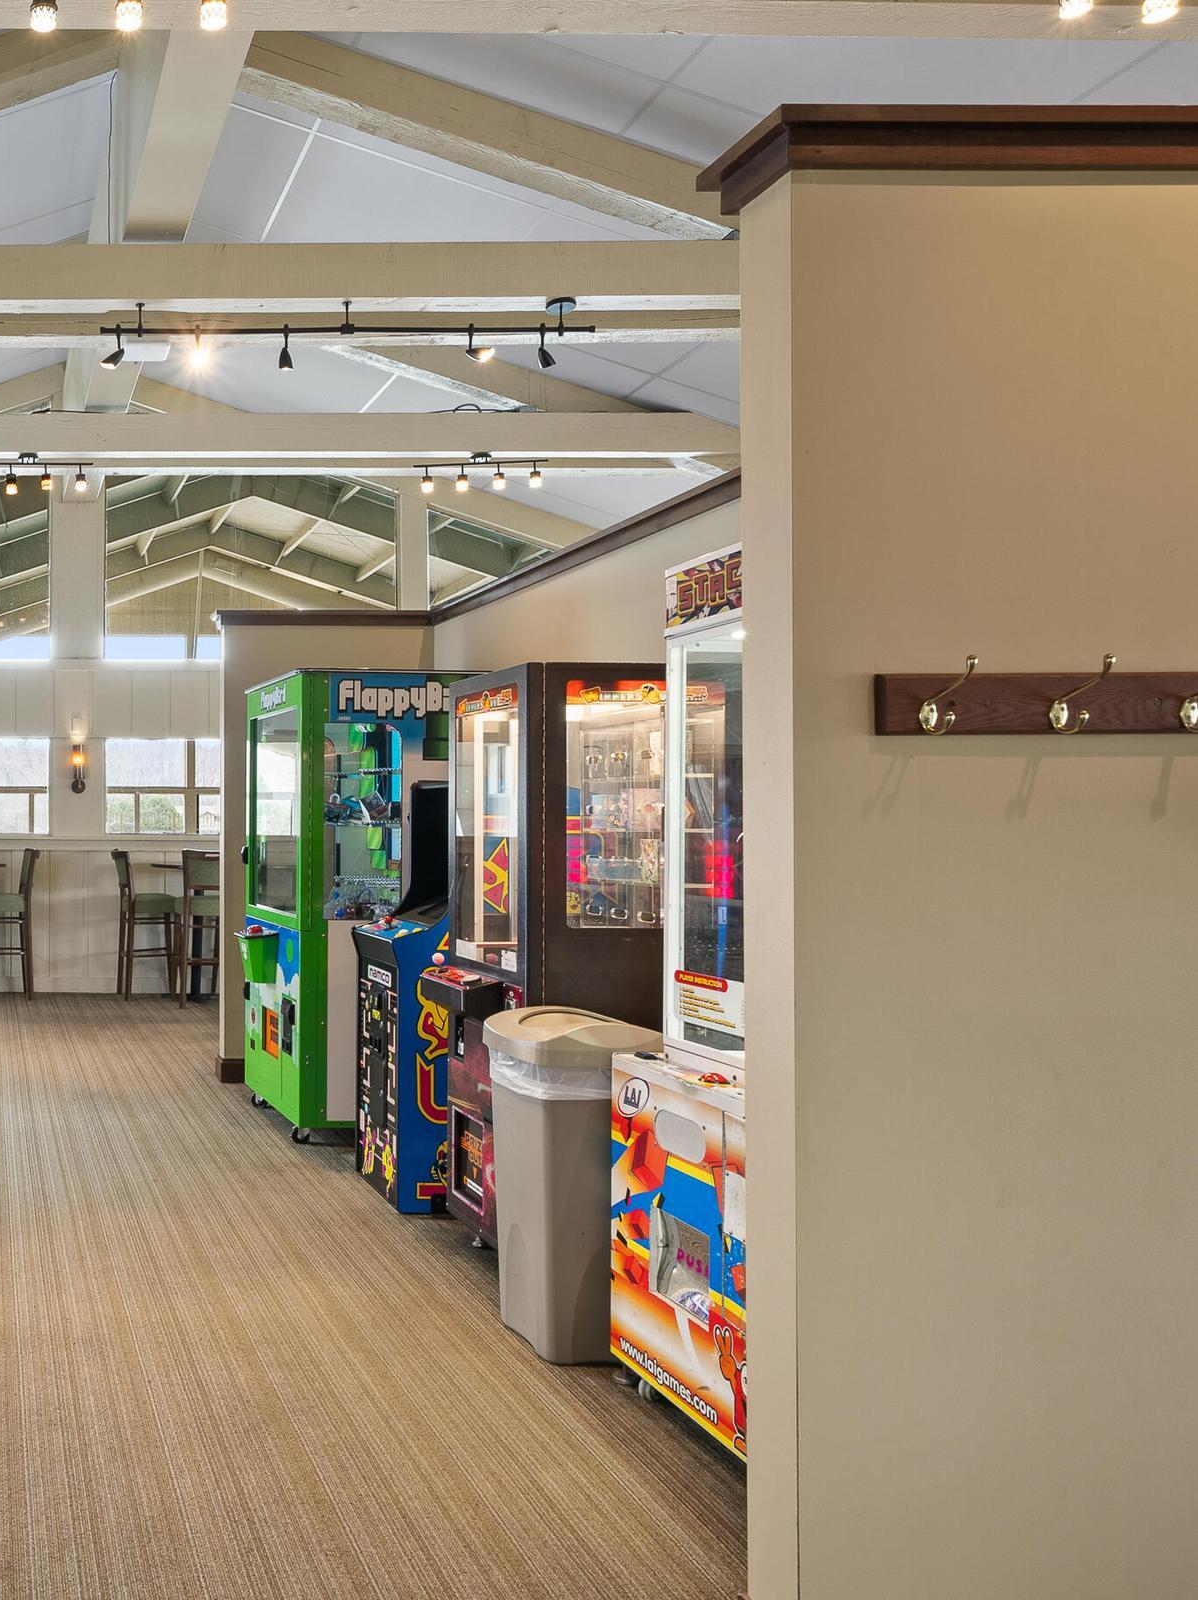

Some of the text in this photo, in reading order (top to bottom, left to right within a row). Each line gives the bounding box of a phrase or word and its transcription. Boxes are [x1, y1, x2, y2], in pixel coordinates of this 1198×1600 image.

[677, 559, 742, 615] STAC
[337, 679, 450, 720] FlappyBi
[369, 966, 391, 985] namco
[623, 1085, 642, 1108] LAI
[464, 1130, 483, 1152] PRIZ
[619, 1336, 719, 1426] www.laigames.com
